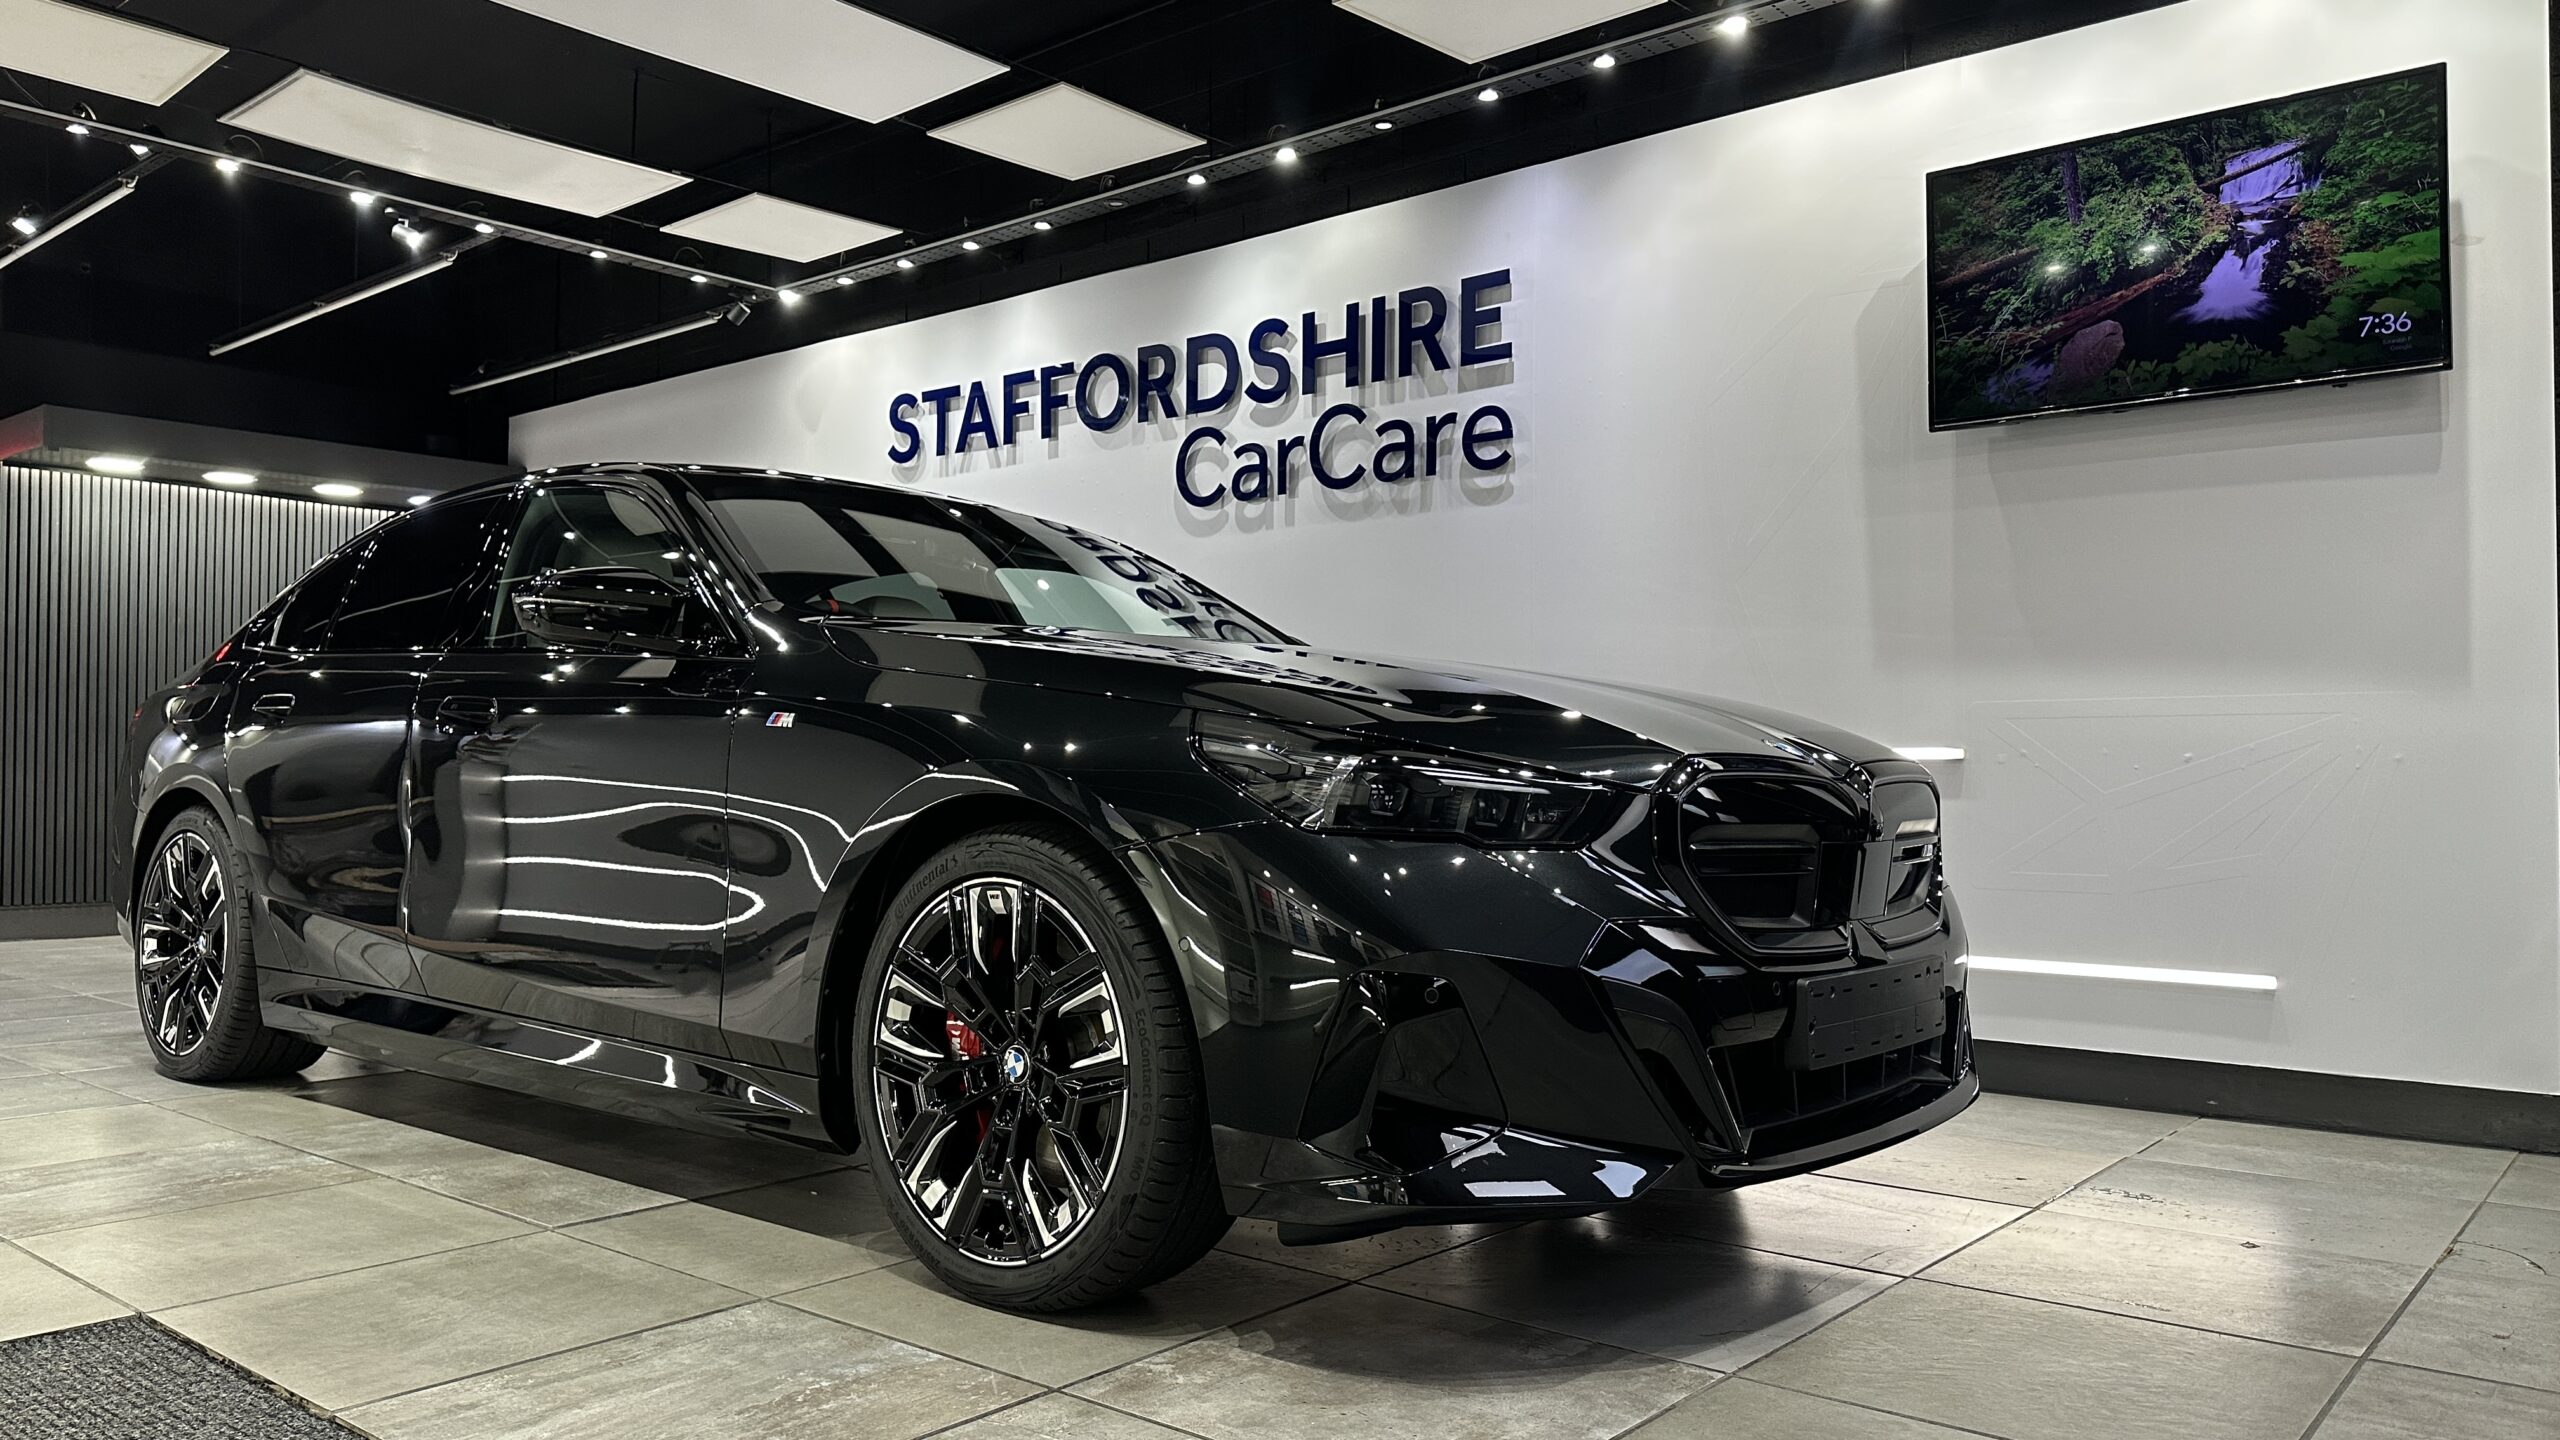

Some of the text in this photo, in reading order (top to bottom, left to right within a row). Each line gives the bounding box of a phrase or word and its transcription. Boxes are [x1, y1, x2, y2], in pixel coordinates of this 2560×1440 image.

[887, 268, 1513, 464] STAFFORDSHIRE
[2358, 311, 2412, 338] 7:36
[1175, 403, 1513, 508] CarCare
[895, 858, 949, 918] Continental
[1135, 1008, 1153, 1098] EcoContact
